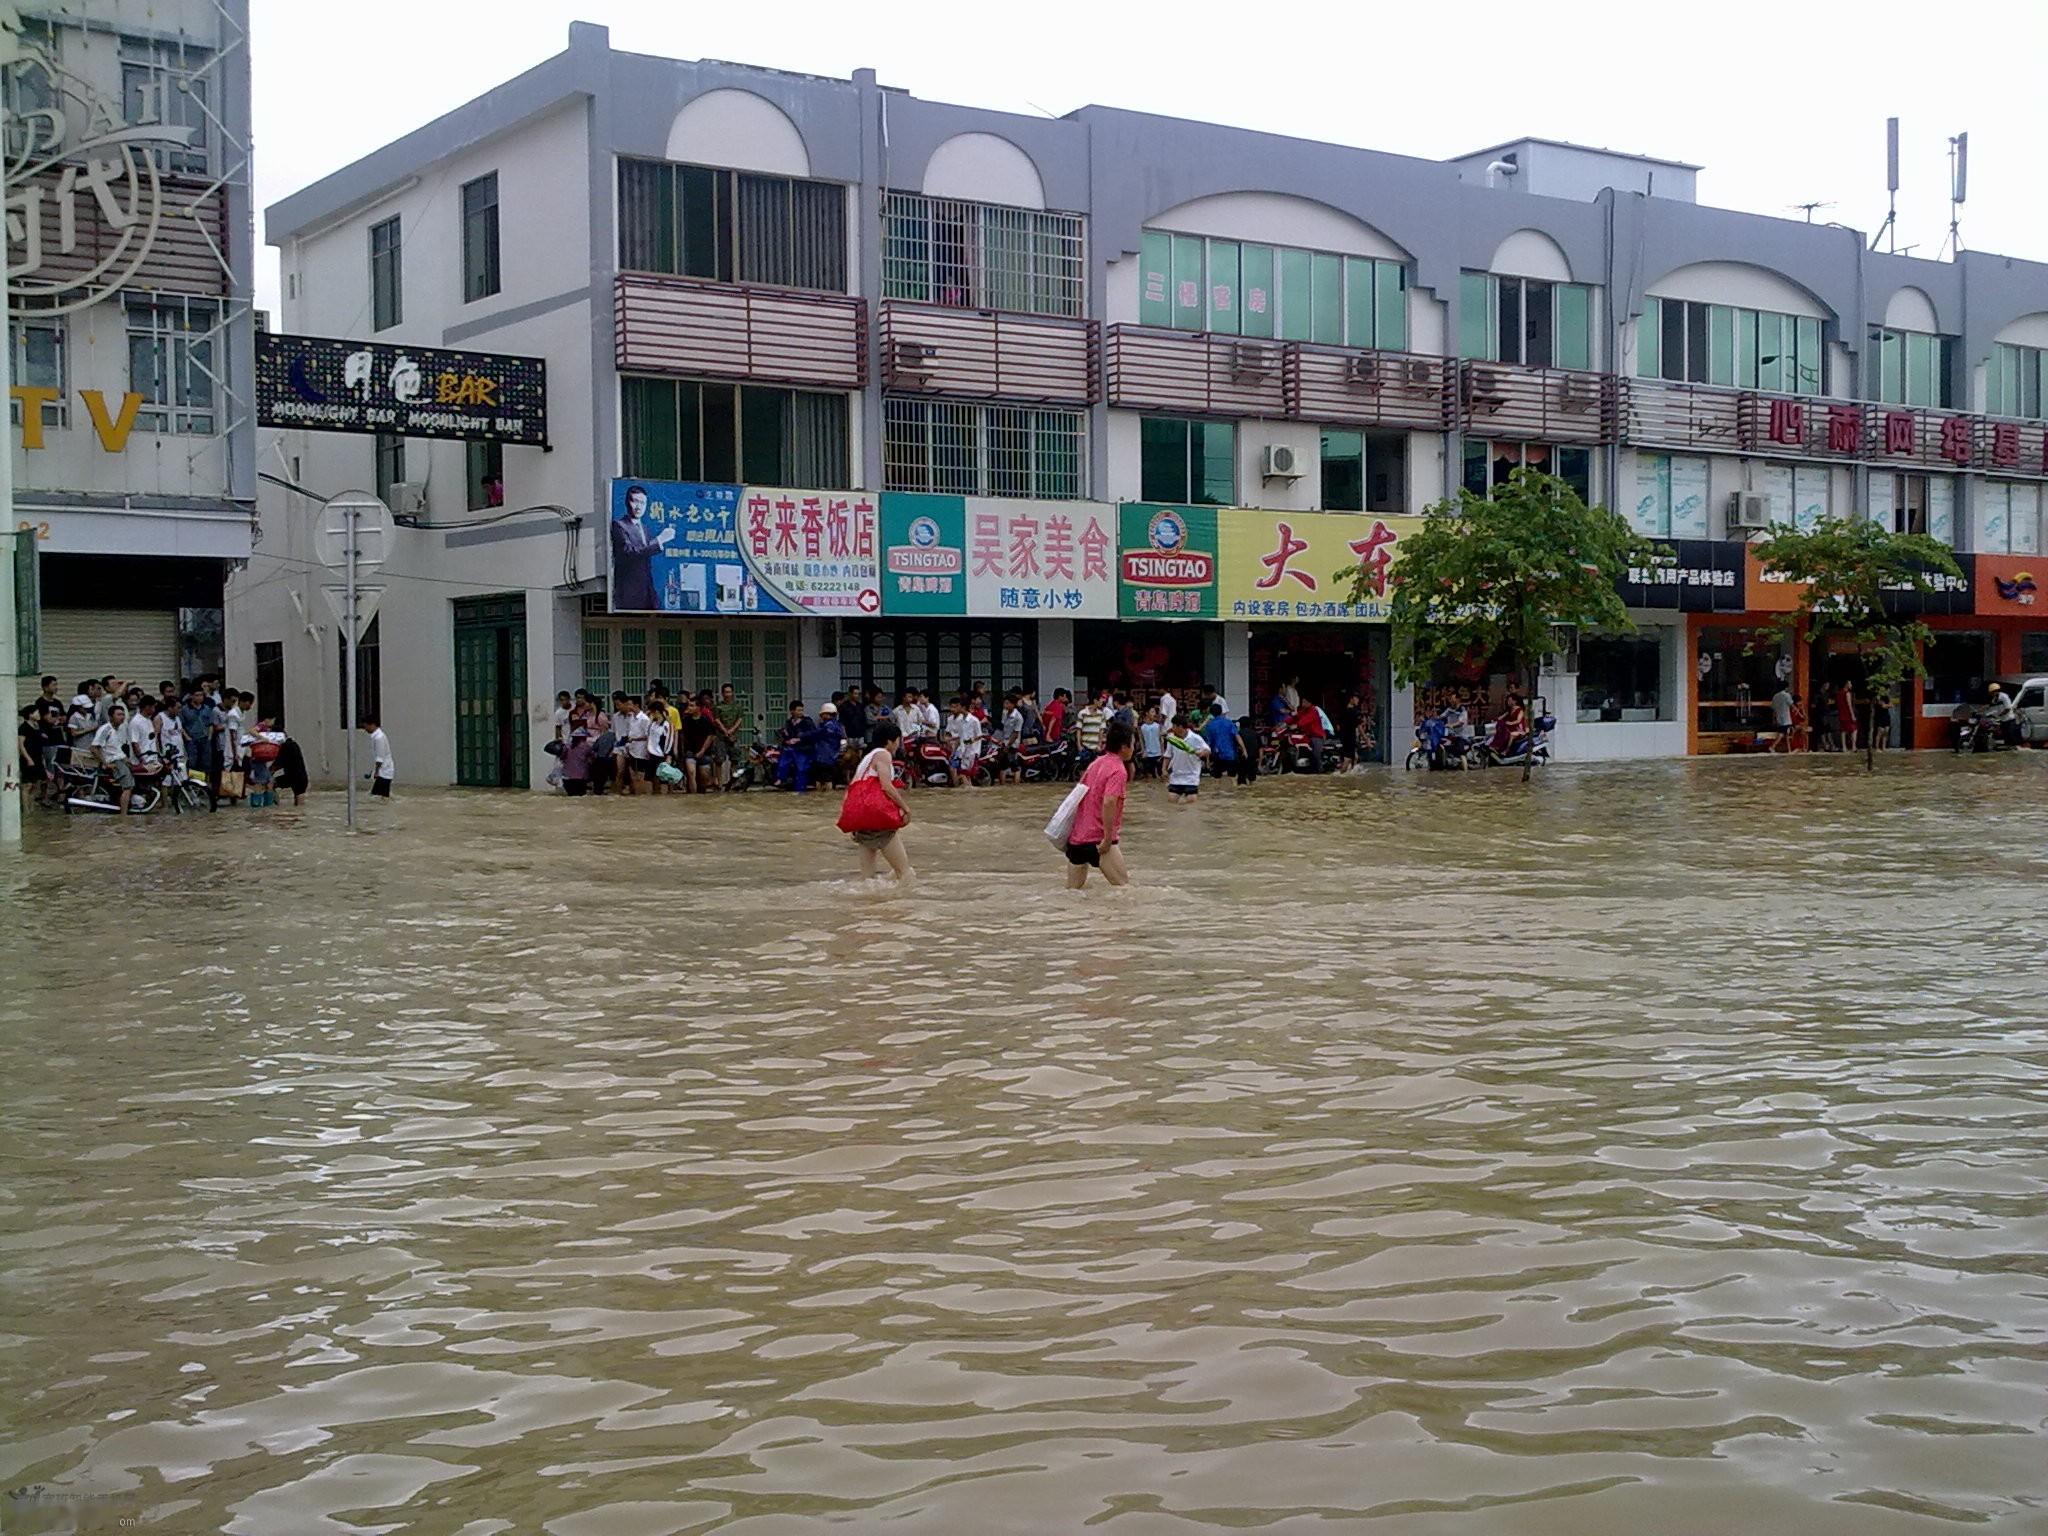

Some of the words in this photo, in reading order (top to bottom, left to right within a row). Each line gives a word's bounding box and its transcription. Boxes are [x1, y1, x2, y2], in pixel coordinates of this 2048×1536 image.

[344, 351, 432, 404] 月色
[436, 373, 496, 407] BAR
[271, 402, 358, 422] MOONLIGHT
[366, 408, 396, 424] BAR
[408, 411, 490, 431] MOONLIGHT
[495, 417, 523, 434] BAR
[748, 494, 873, 557] 客来香饭店
[972, 513, 1109, 581] 吴家美食
[893, 552, 956, 567] TSINGTAO
[1127, 557, 1207, 579] TSINGTAO
[1000, 587, 1083, 609] 随意小炒
[1135, 590, 1200, 612] 青岛啤酒
[1234, 600, 1289, 616] 内设客房
[1296, 602, 1349, 617] 包办酒席
